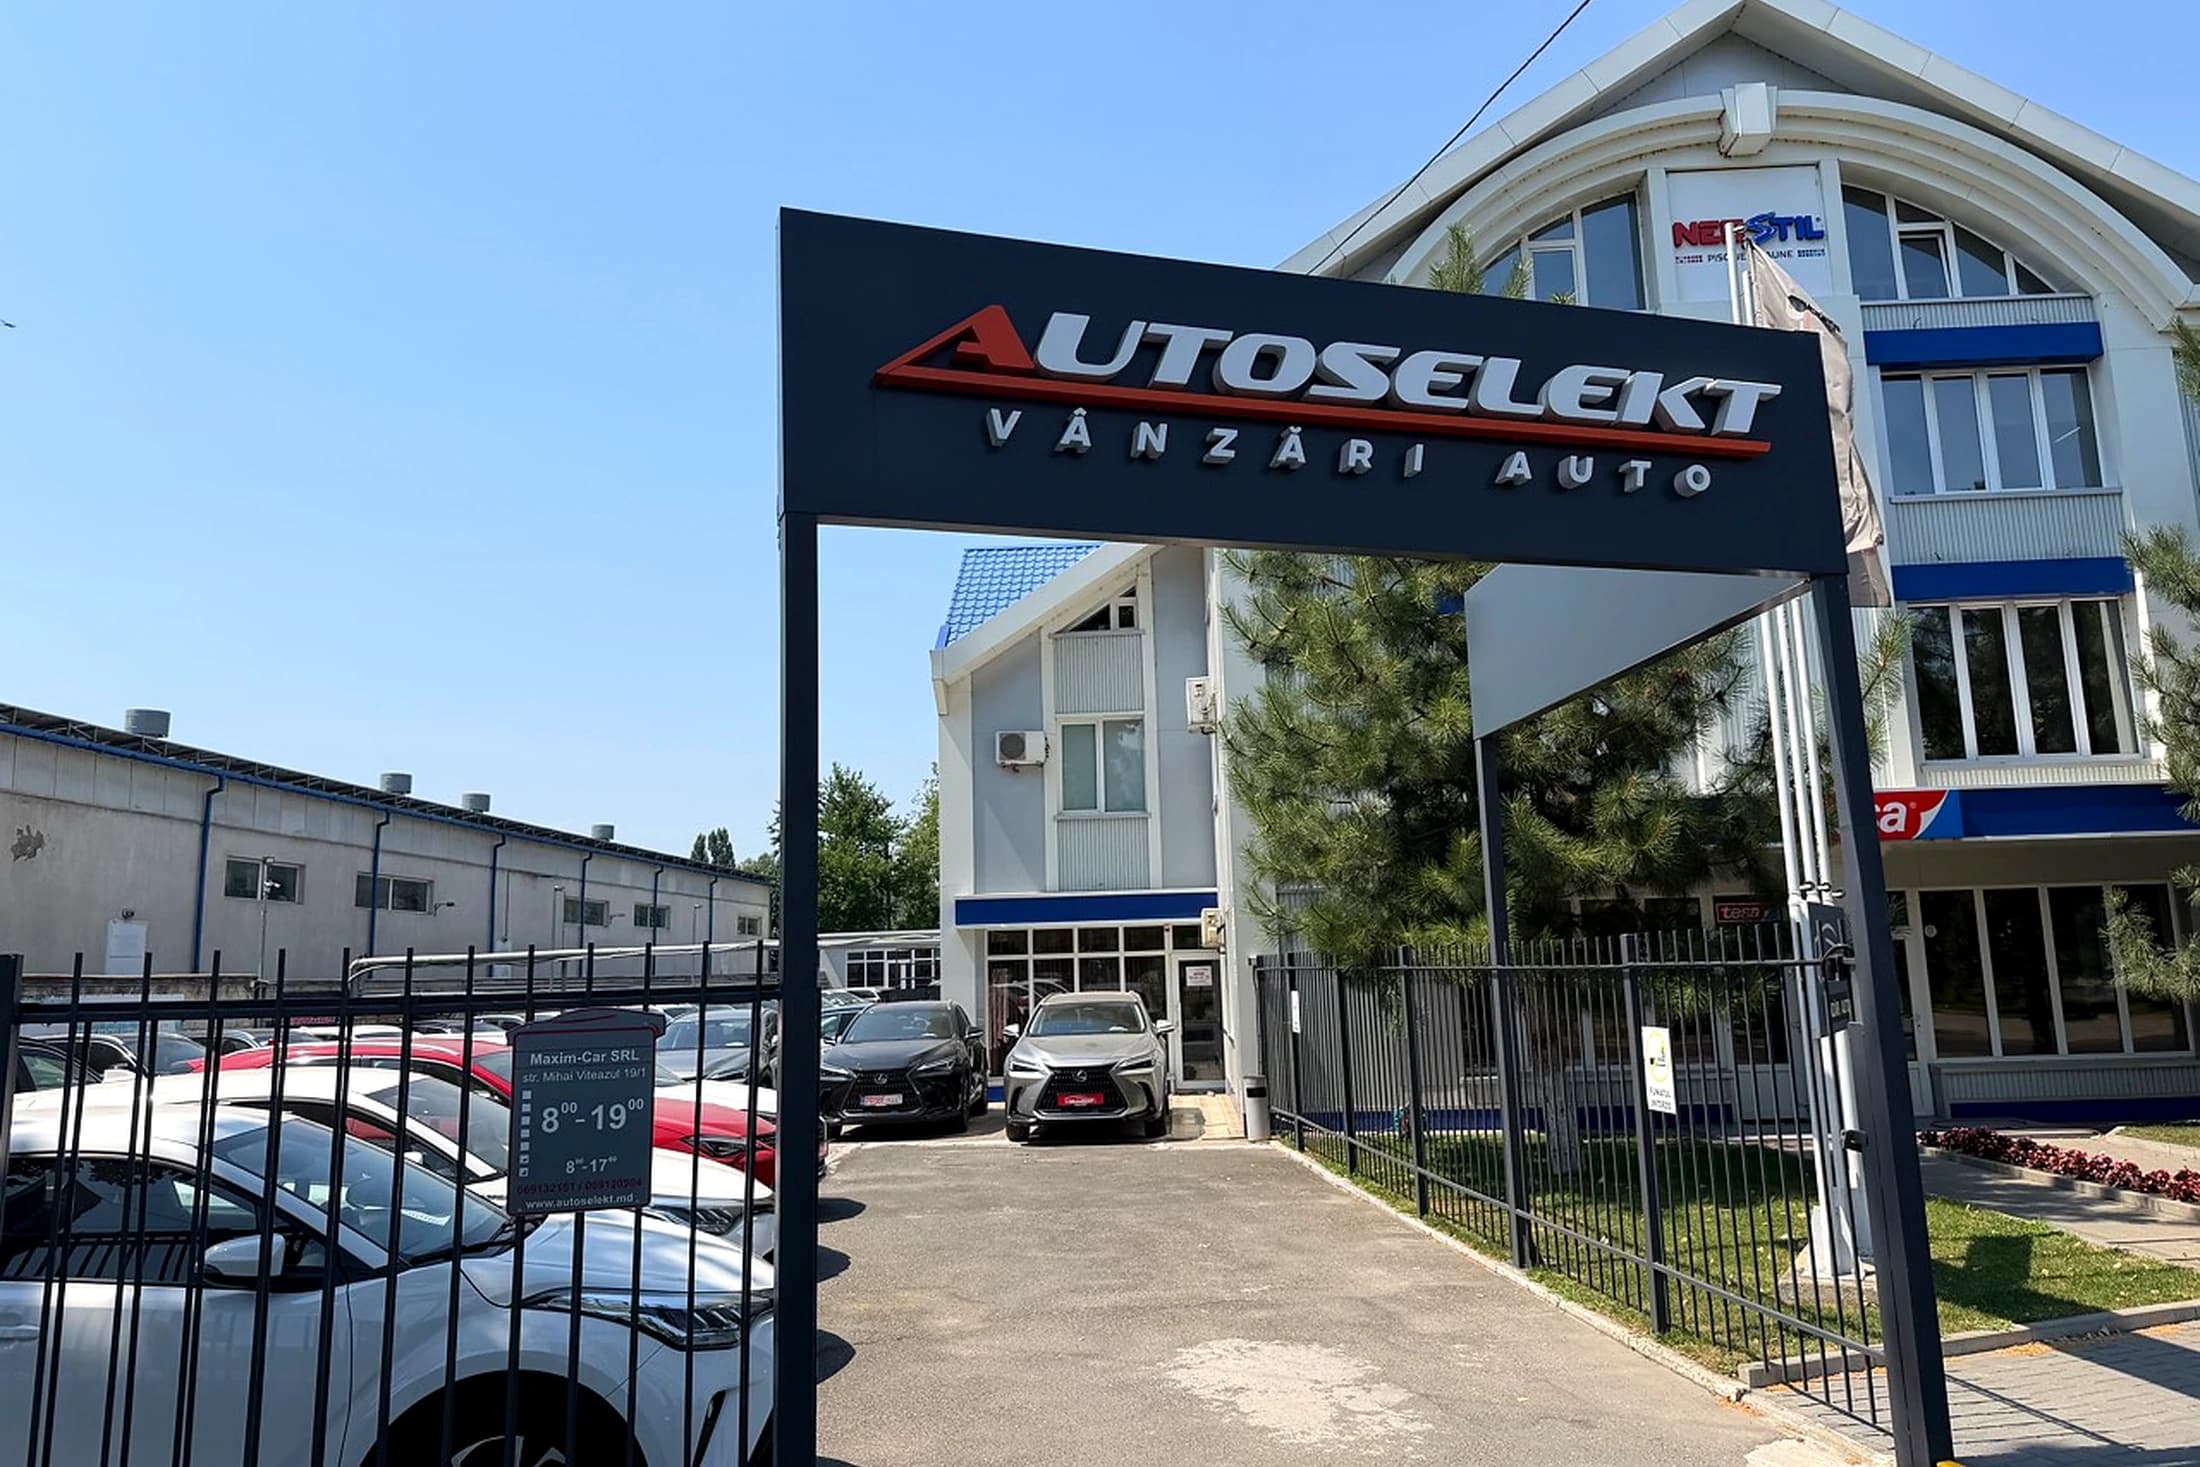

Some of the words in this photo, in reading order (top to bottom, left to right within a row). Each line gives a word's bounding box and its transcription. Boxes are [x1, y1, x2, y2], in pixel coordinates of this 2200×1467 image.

[876, 304, 1782, 436] AUTOSELEKT
[986, 407, 1424, 477] VÂNZĂRI
[1496, 451, 1712, 498] AUTO
[522, 1073, 540, 1083] str.
[543, 1071, 573, 1082] Mihai
[576, 1069, 620, 1081] Viteazul
[624, 1067, 646, 1079] 19/1
[530, 1051, 606, 1066] Maxim-Car
[611, 1050, 640, 1062] SRL
